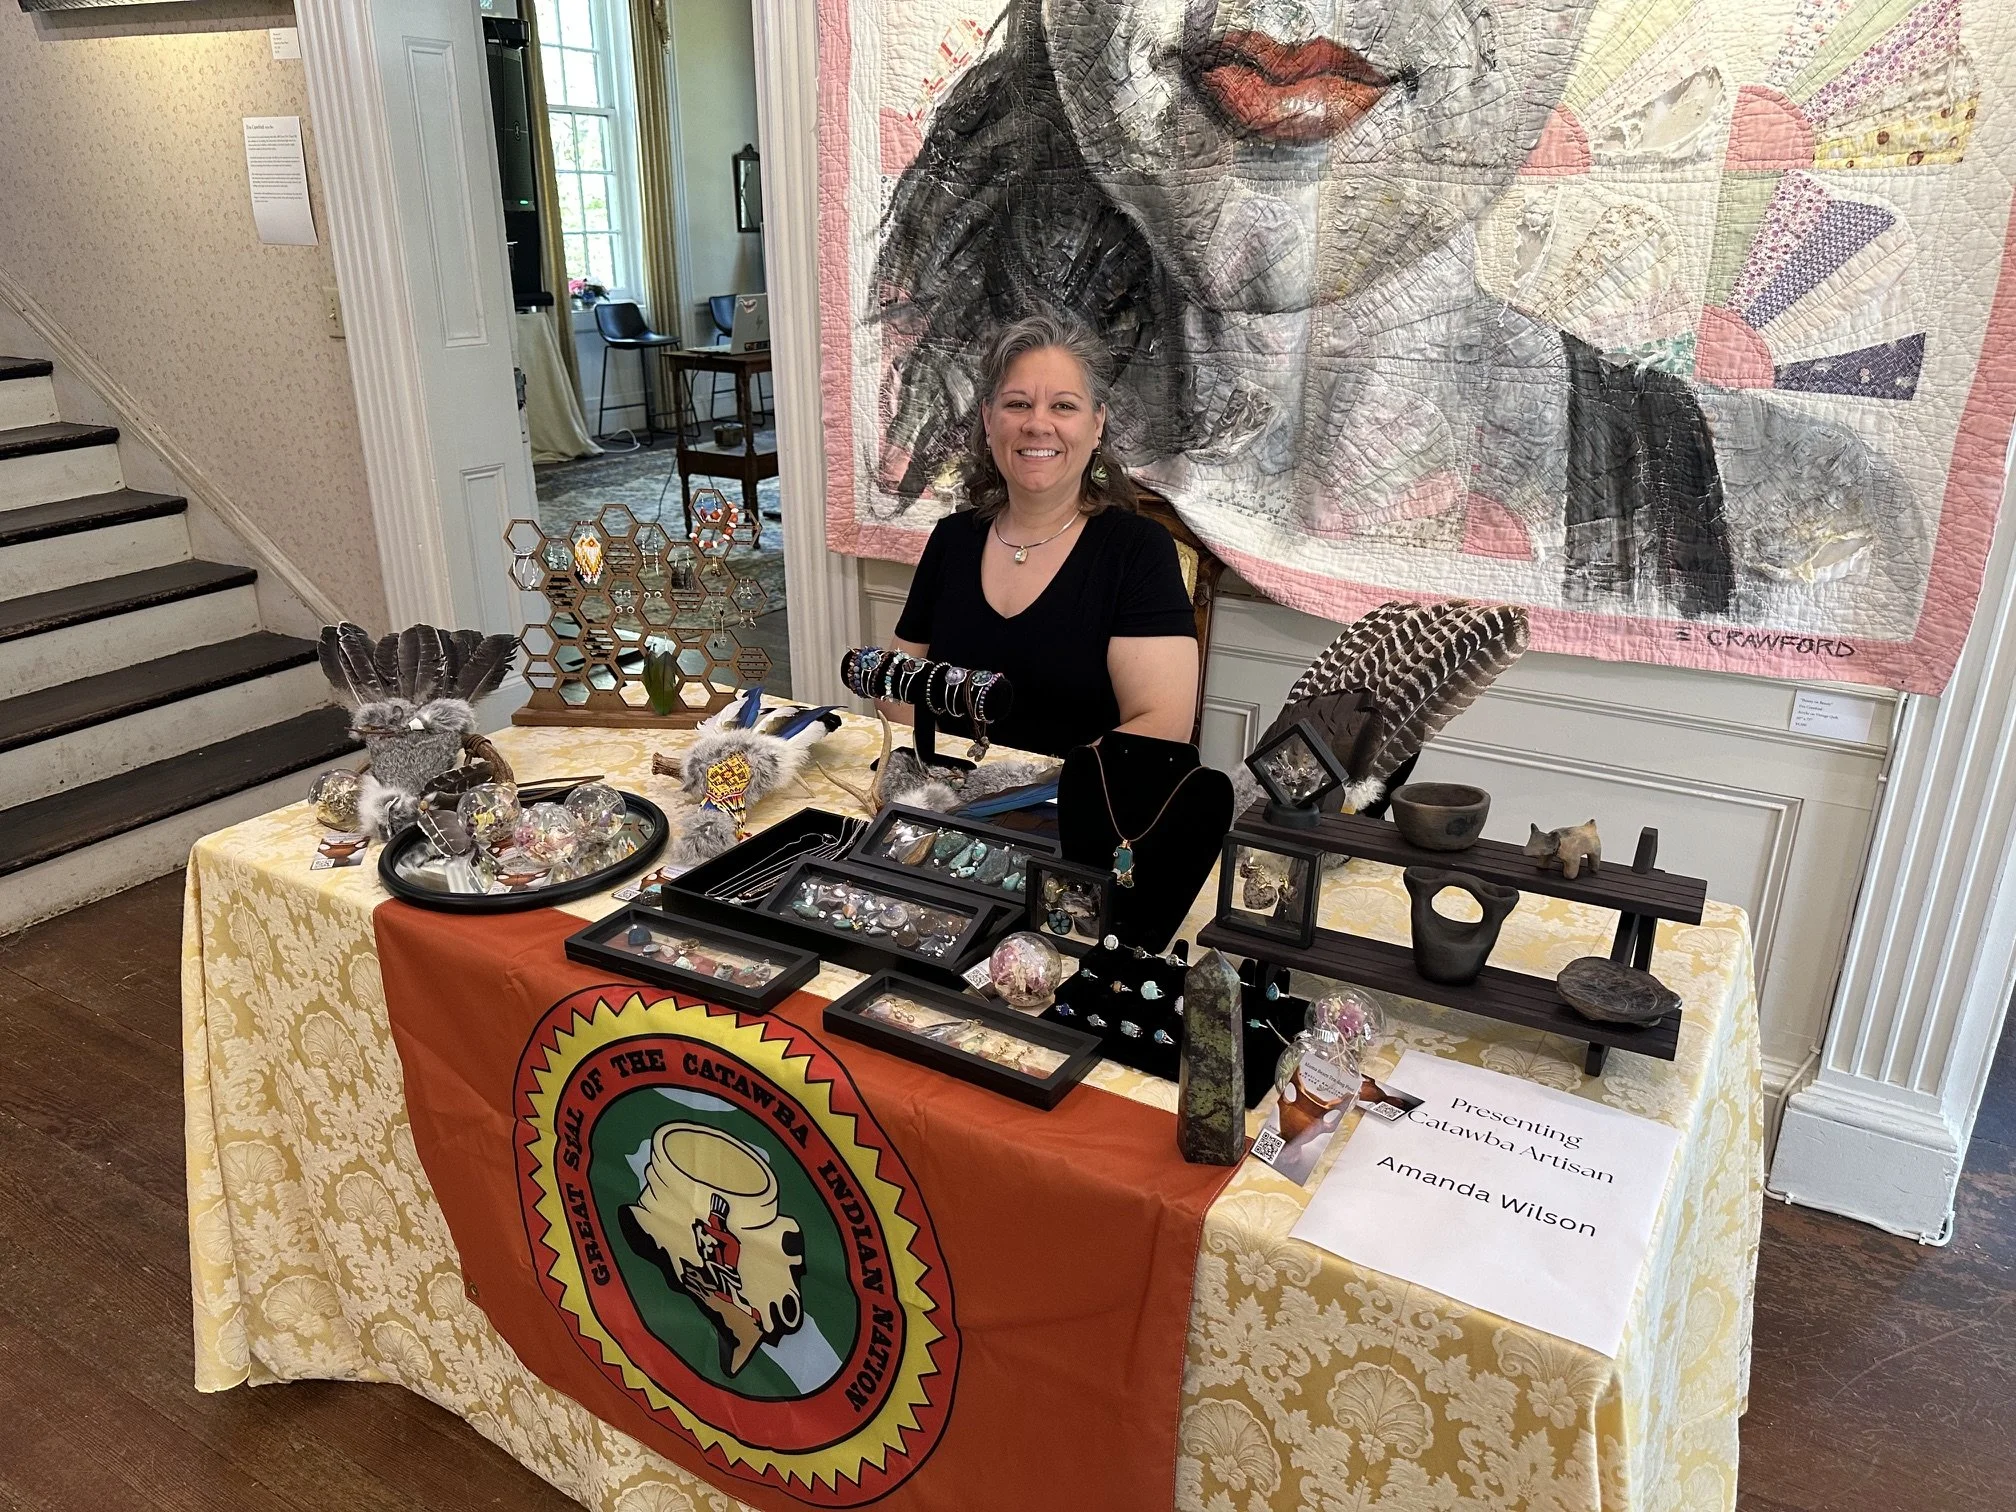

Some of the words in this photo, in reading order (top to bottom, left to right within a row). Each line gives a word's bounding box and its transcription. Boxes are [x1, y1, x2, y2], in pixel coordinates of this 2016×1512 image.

[1707, 629, 1856, 658] CRAWFORD
[581, 1068, 603, 1101] OF
[611, 1049, 666, 1079] THE
[683, 1053, 812, 1150] CATAWBA
[562, 1107, 585, 1170] SEAL
[1408, 1109, 1517, 1152] Catawba
[1519, 1144, 1616, 1184] Artisan
[1451, 1097, 1583, 1149] Presenting
[817, 1159, 886, 1295] INDIAN
[1377, 1155, 1490, 1203] Amanda
[1501, 1194, 1598, 1238] Wilson
[568, 1184, 612, 1287] GREAT
[845, 1304, 894, 1412] NATION
